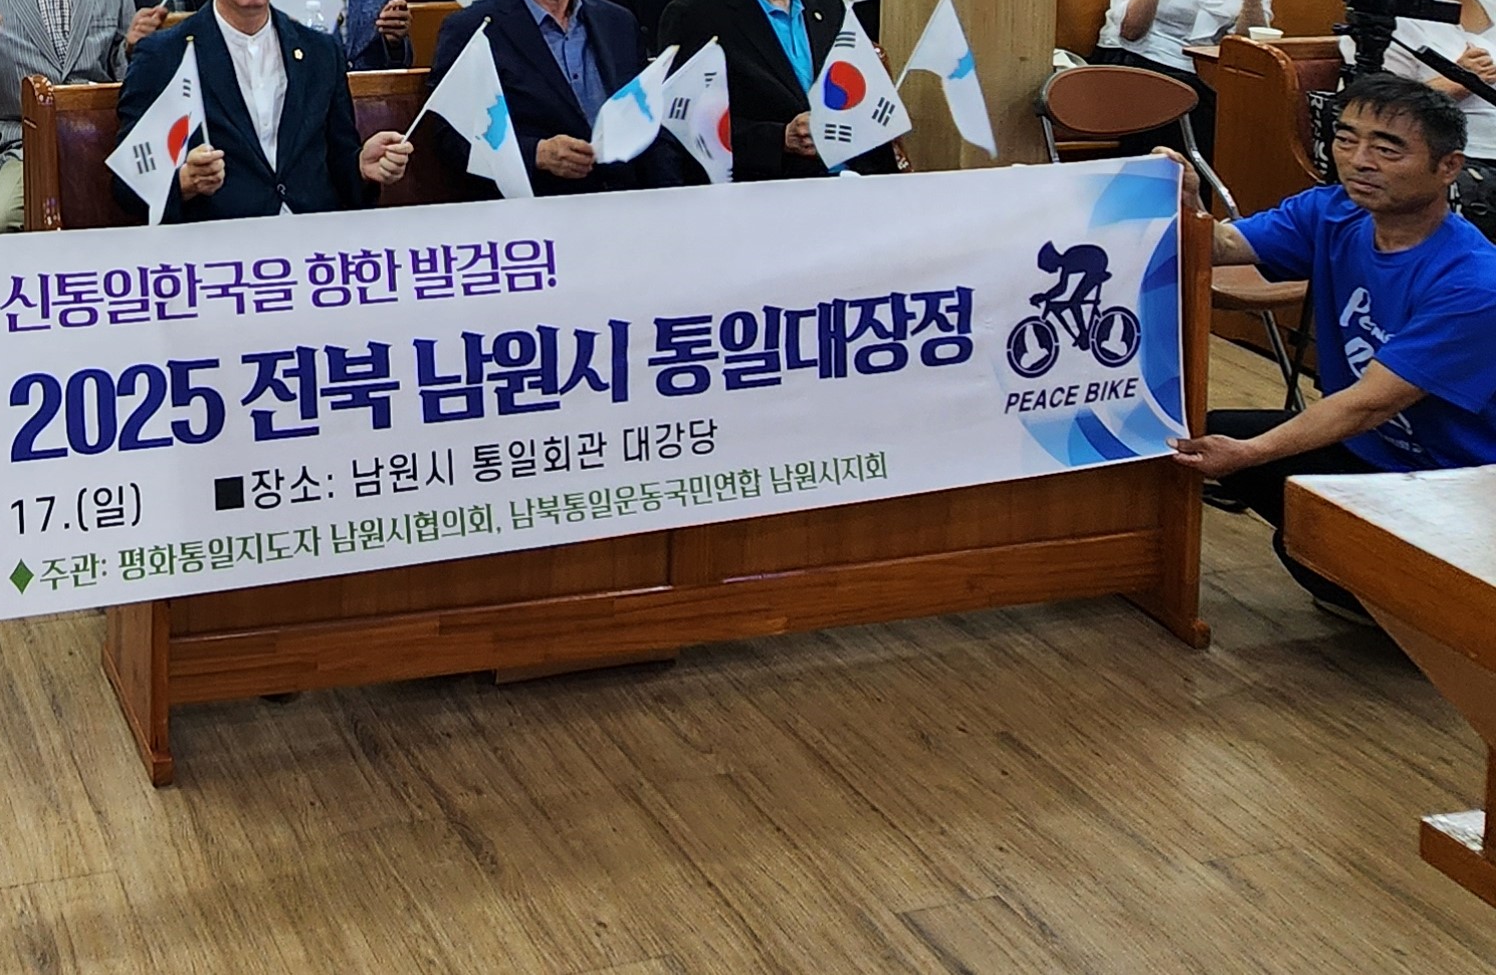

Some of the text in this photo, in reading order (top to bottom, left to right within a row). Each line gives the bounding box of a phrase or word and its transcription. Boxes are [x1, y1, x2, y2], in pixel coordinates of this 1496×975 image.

[0, 259, 298, 332] 신통일한국을
[305, 248, 402, 307] 향한
[409, 239, 556, 300] 발걸음!
[10, 358, 225, 463] 2025
[241, 341, 400, 442] 전북
[413, 319, 631, 424] 남원시
[648, 286, 974, 397] 통일대장정
[1005, 379, 1137, 414] PEACE BIKE
[11, 483, 141, 534] 17.(일)
[252, 419, 718, 509] 장소: 남원시 통일회관 대강당
[40, 451, 887, 590] 주관: 평화통일지도자 남원시협의회, 남북통일운동국민연합 남원시지회
